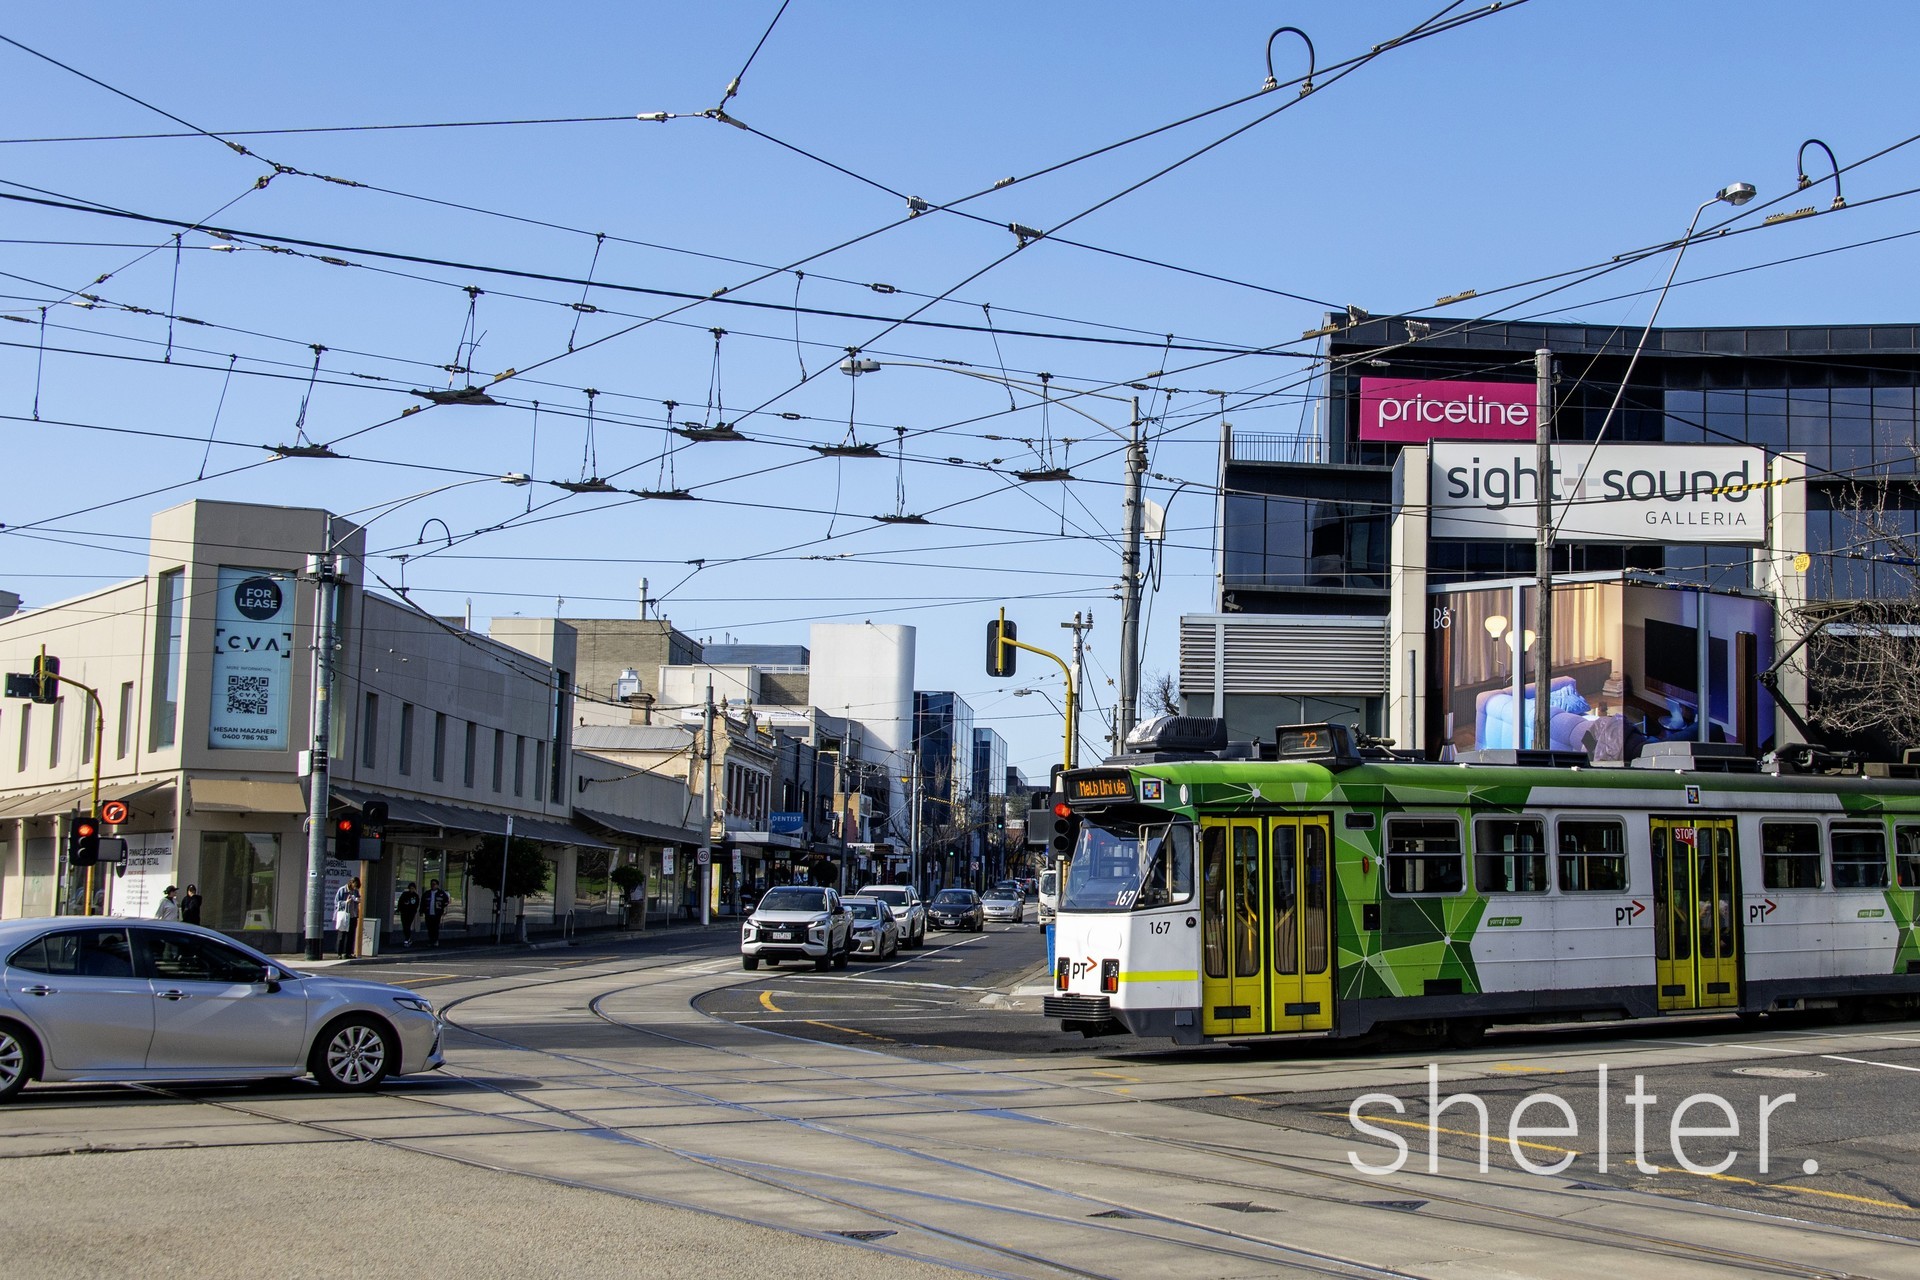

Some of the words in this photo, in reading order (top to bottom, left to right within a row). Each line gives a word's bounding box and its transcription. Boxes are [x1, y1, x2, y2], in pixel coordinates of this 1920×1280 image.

[1378, 393, 1530, 429] priceline
[1645, 510, 1747, 526] GALLERIA
[1795, 556, 1808, 565] CUT
[1795, 563, 1808, 571] OFF
[246, 588, 272, 599] FOR
[239, 597, 278, 609] LEASE
[228, 635, 279, 652] CVA
[213, 726, 239, 734] HESAN
[240, 727, 277, 735] MAZAHERI
[1302, 732, 1317, 749] 72
[1099, 779, 1113, 796] Uni
[1113, 779, 1128, 795] via
[1675, 828, 1694, 840] STOP
[700, 853, 708, 861] 40
[1115, 890, 1136, 906] 167
[1149, 921, 1171, 935] 167
